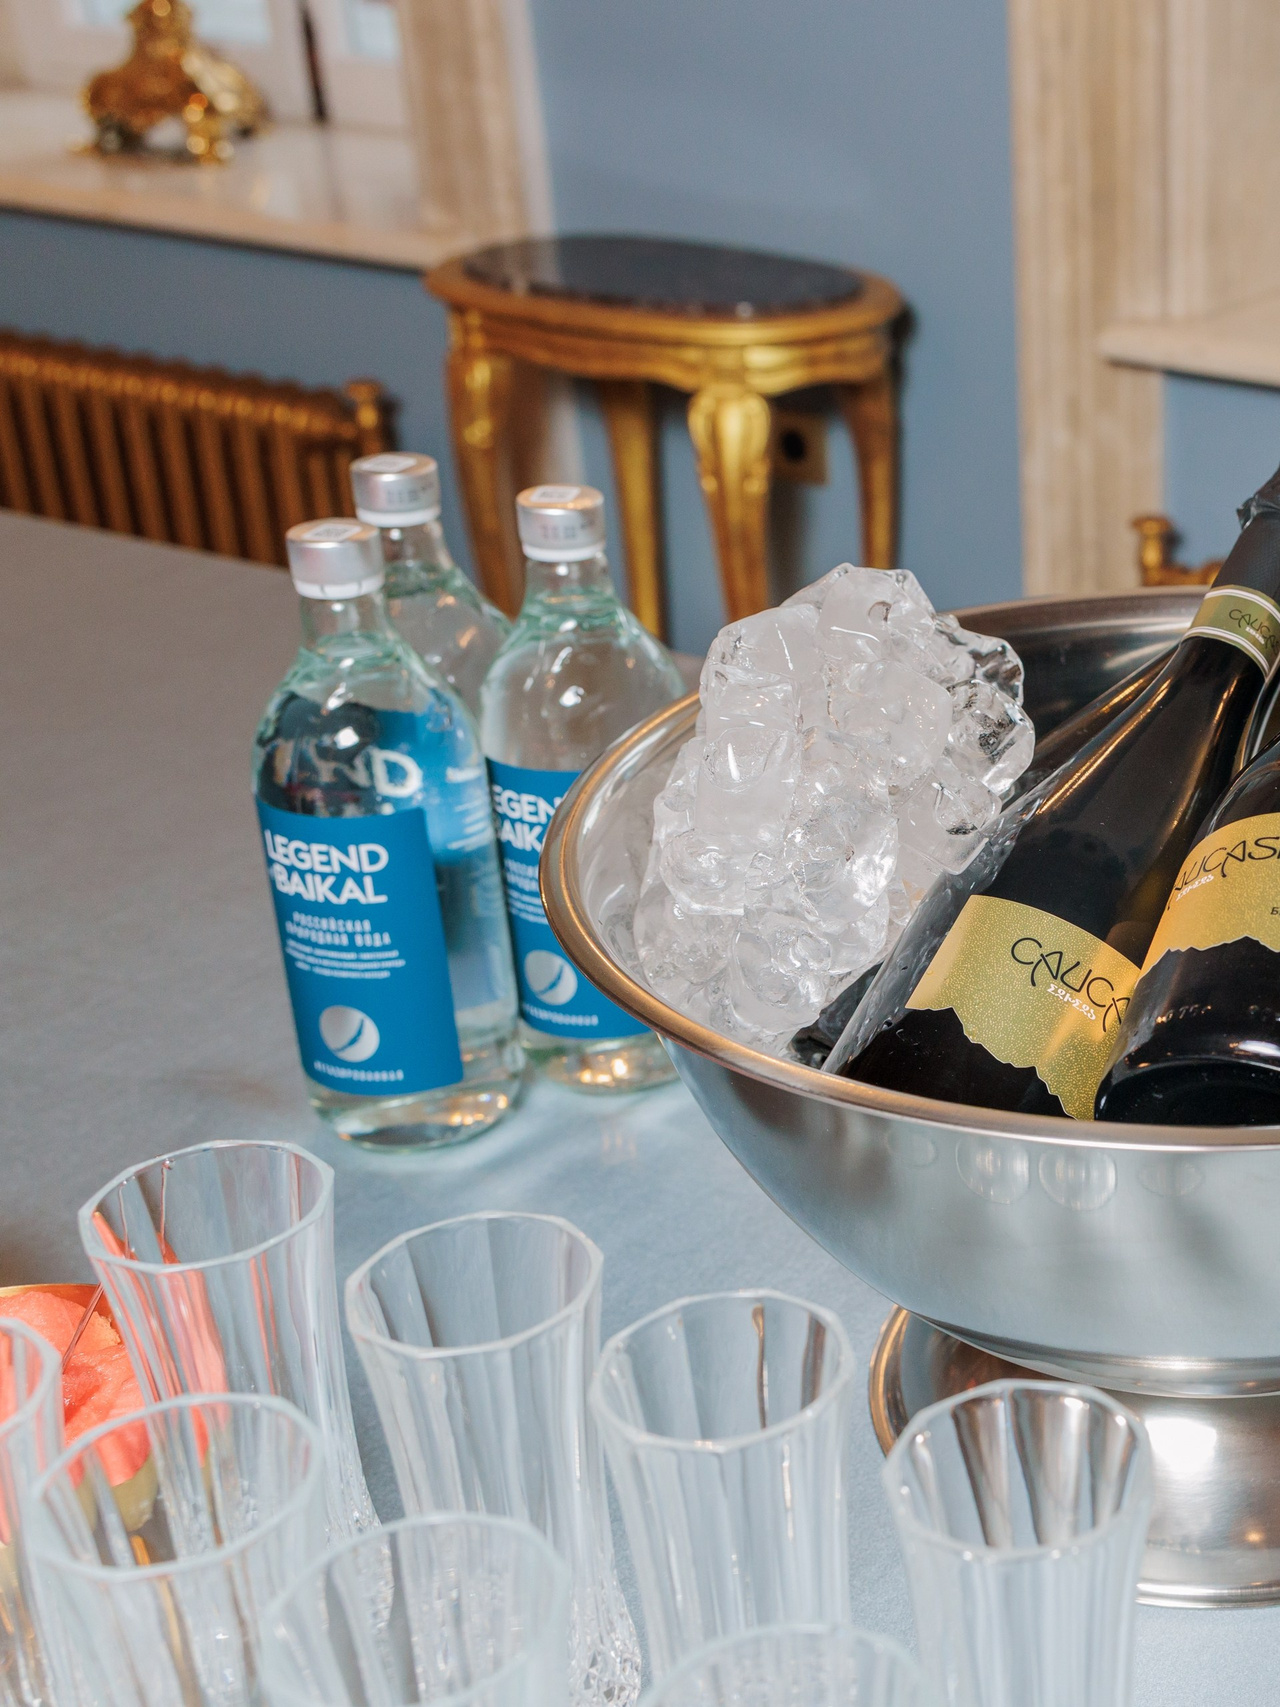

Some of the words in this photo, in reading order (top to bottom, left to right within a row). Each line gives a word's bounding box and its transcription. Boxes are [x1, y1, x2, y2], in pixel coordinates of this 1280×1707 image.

[264, 829, 389, 874] LEGEND
[272, 862, 388, 905] BAIKAL
[1011, 937, 1131, 1033] CAUCA
